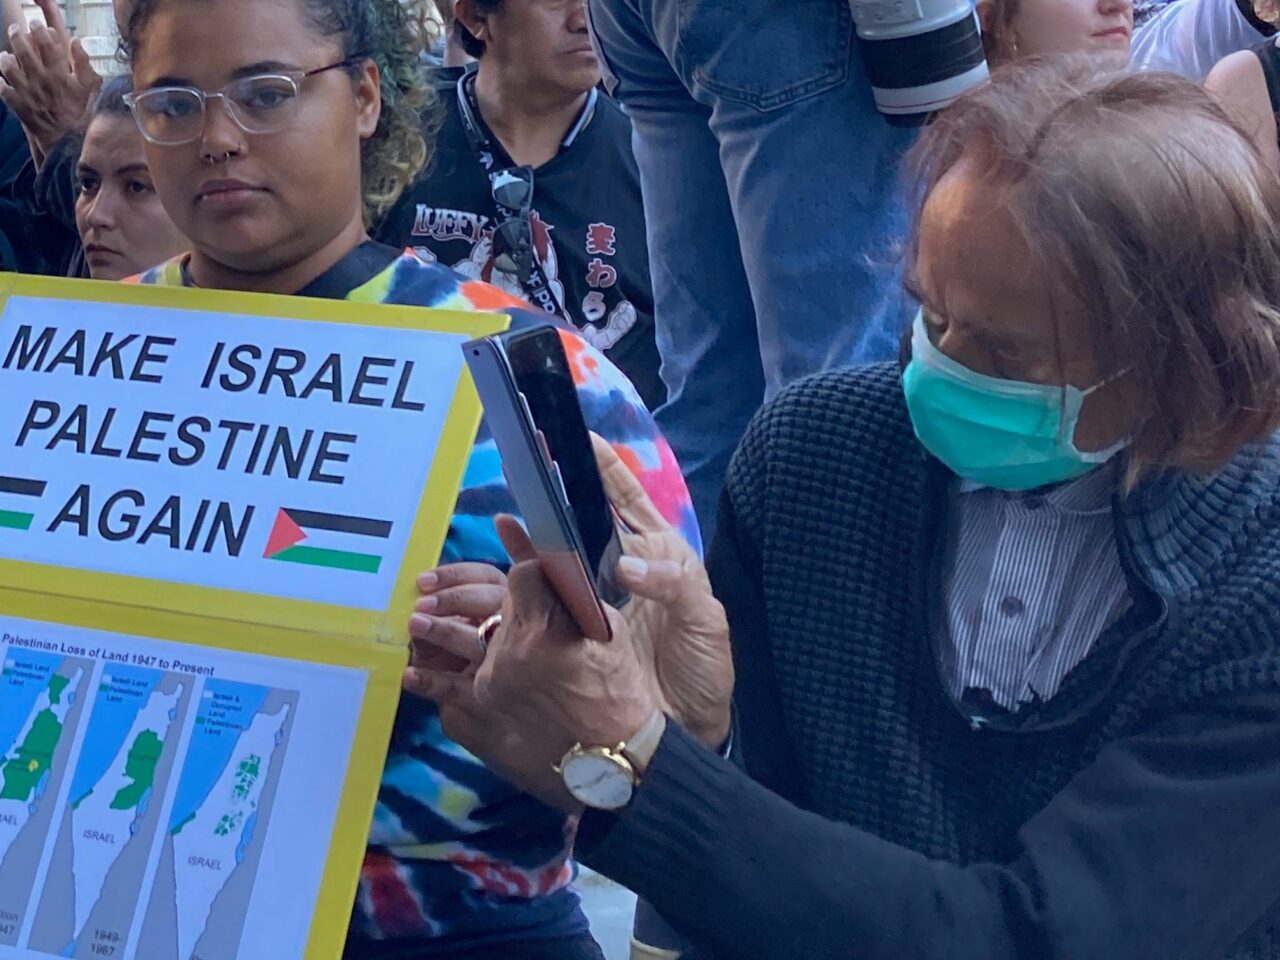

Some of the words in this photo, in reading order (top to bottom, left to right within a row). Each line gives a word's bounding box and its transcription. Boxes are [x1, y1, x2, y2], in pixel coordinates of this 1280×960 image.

[411, 204, 490, 244] LUFFY
[2, 324, 177, 384] MAKE
[201, 341, 428, 412] ISRAEL
[14, 399, 358, 485] PALESTINE
[46, 484, 255, 558] AGAIN
[2, 633, 58, 651] Palestinian
[60, 642, 86, 656] Loss
[88, 648, 100, 658] of
[101, 649, 129, 662] Land
[131, 653, 157, 667] 1947
[158, 656, 170, 669] to
[172, 660, 215, 676] Present
[83, 829, 116, 844] ISRAEL
[188, 856, 221, 871] ISRAEL
